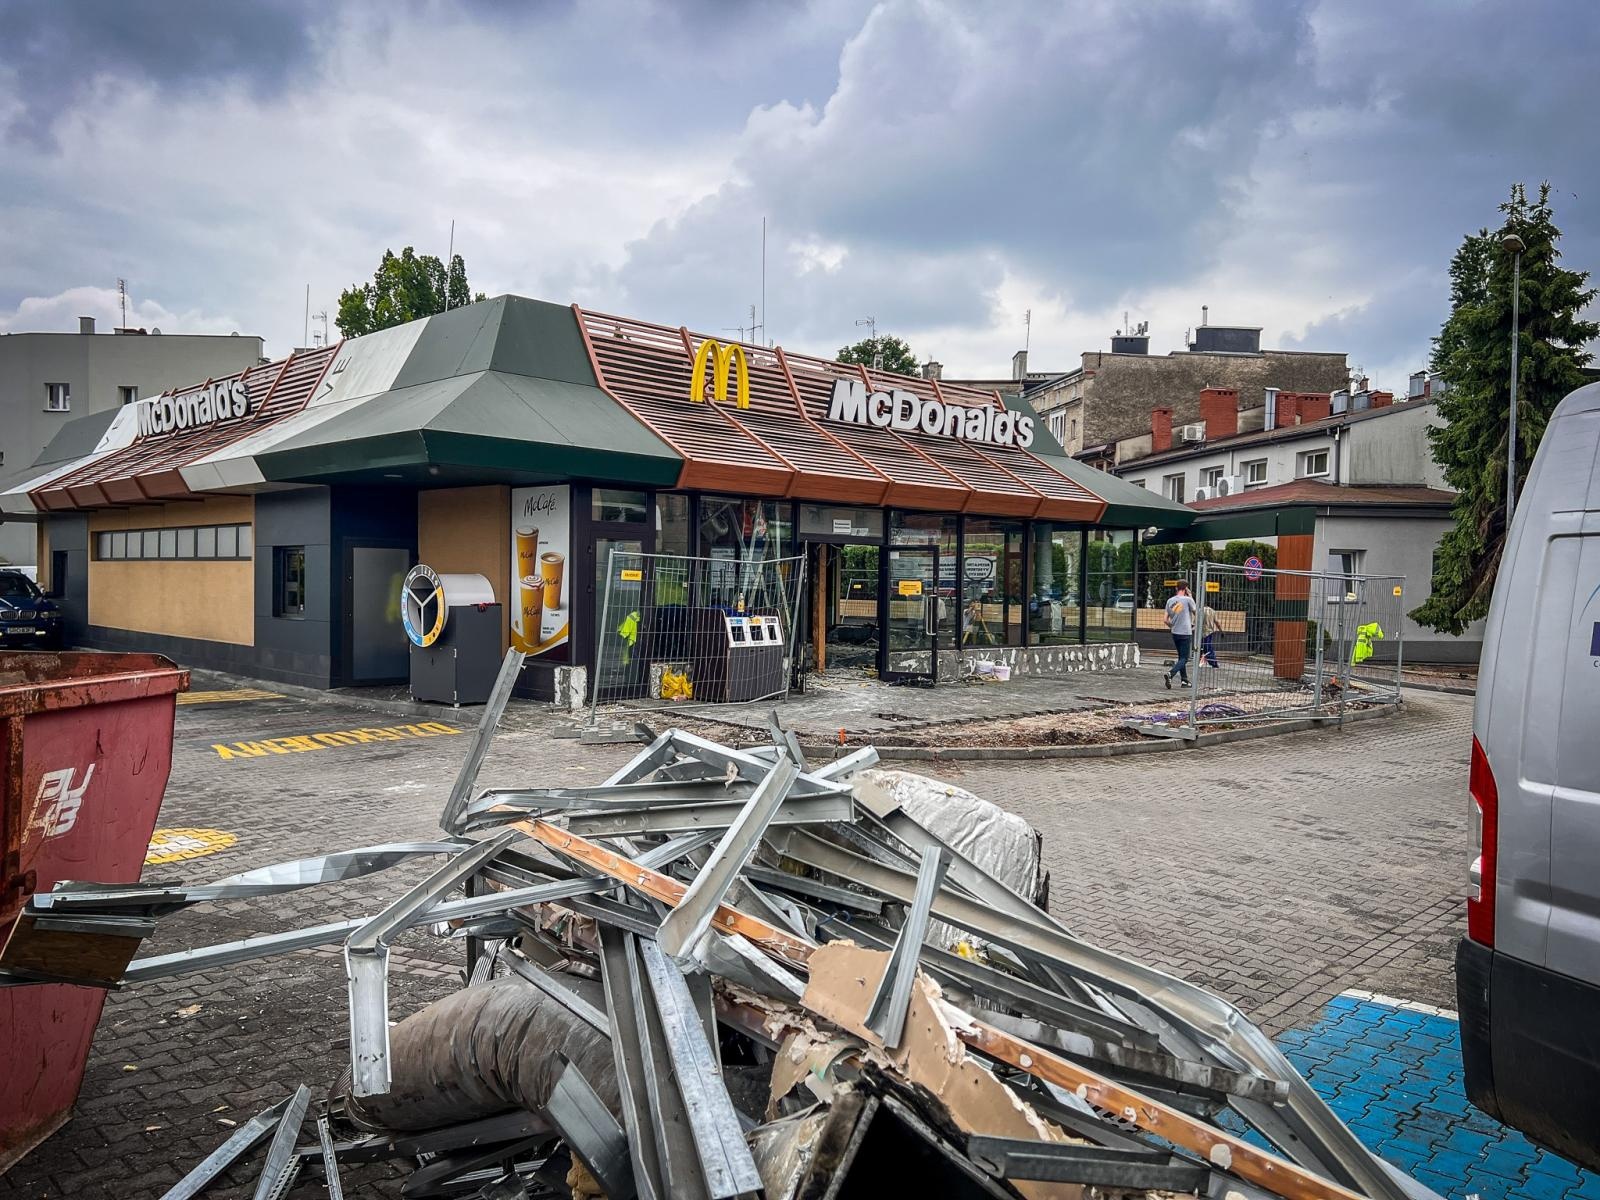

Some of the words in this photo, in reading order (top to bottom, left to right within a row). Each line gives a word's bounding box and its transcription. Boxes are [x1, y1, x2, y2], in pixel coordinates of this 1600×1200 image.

[137, 380, 248, 437] McDonald's
[828, 379, 1034, 448] McDonald's
[523, 493, 557, 517] McCafé
